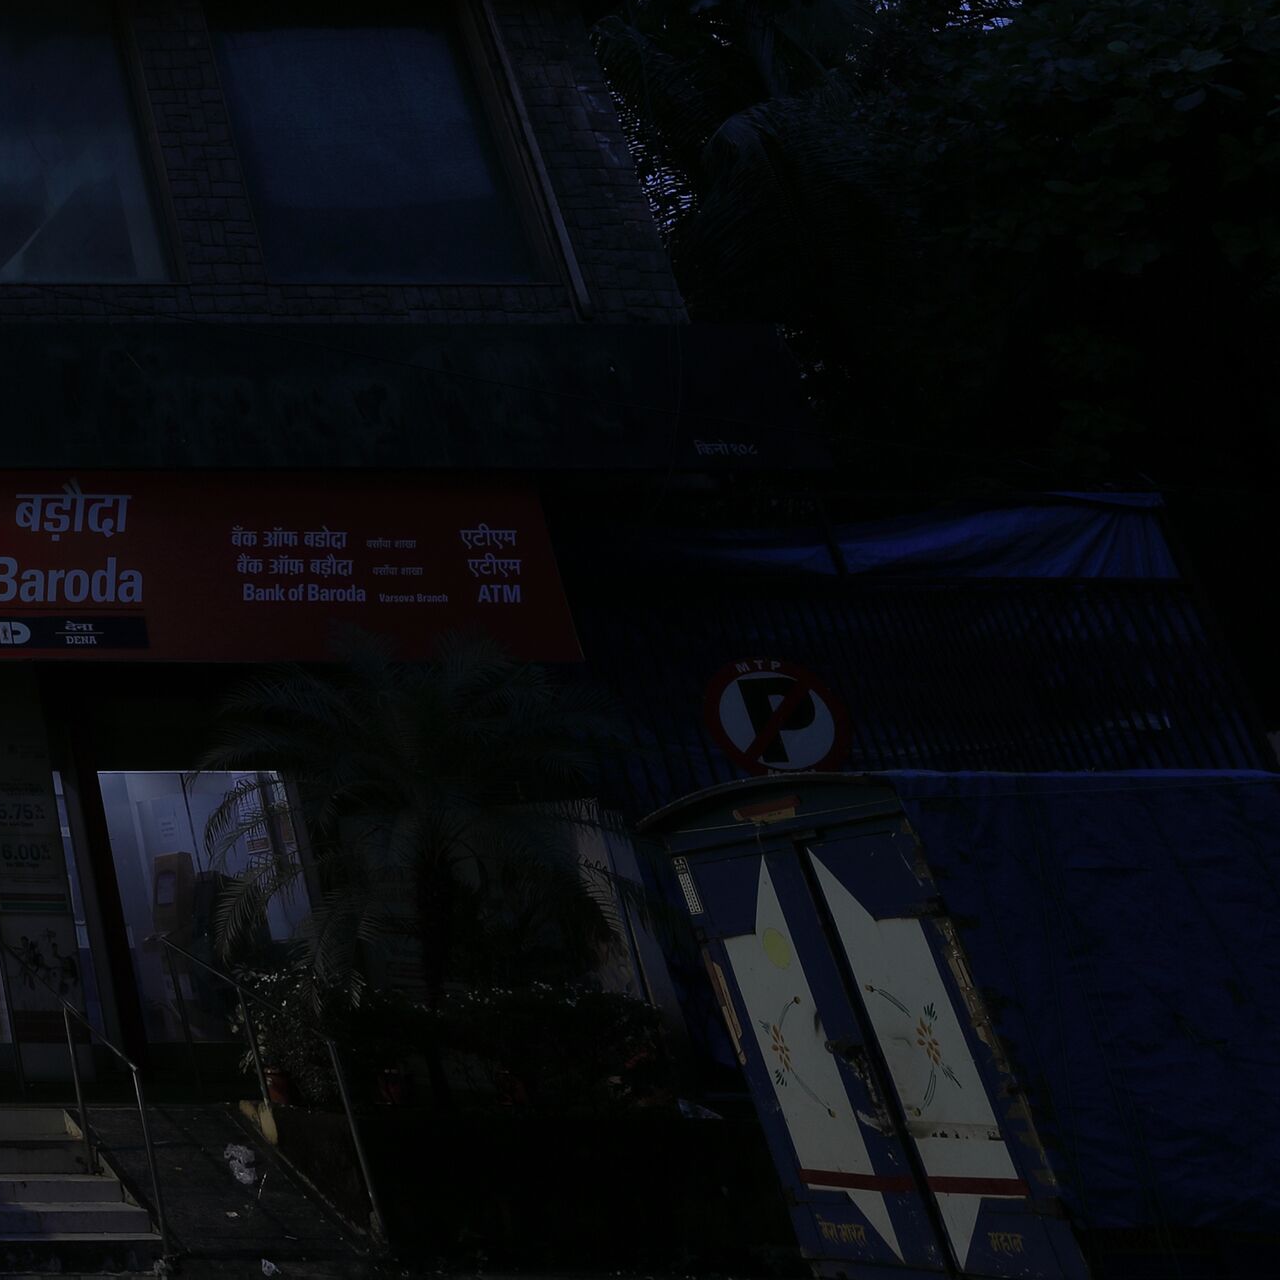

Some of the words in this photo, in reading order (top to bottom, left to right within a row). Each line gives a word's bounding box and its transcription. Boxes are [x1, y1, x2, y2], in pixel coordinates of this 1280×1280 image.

[14, 476, 133, 541] बड़ौदा
[459, 523, 517, 550] एटीएम
[467, 552, 522, 578] एटीएम
[242, 583, 285, 603] Bank
[288, 583, 305, 603] of
[307, 583, 366, 603] Baroda
[477, 584, 522, 604] ATM
[65, 635, 97, 645] DENA
[734, 659, 782, 673] MTP
